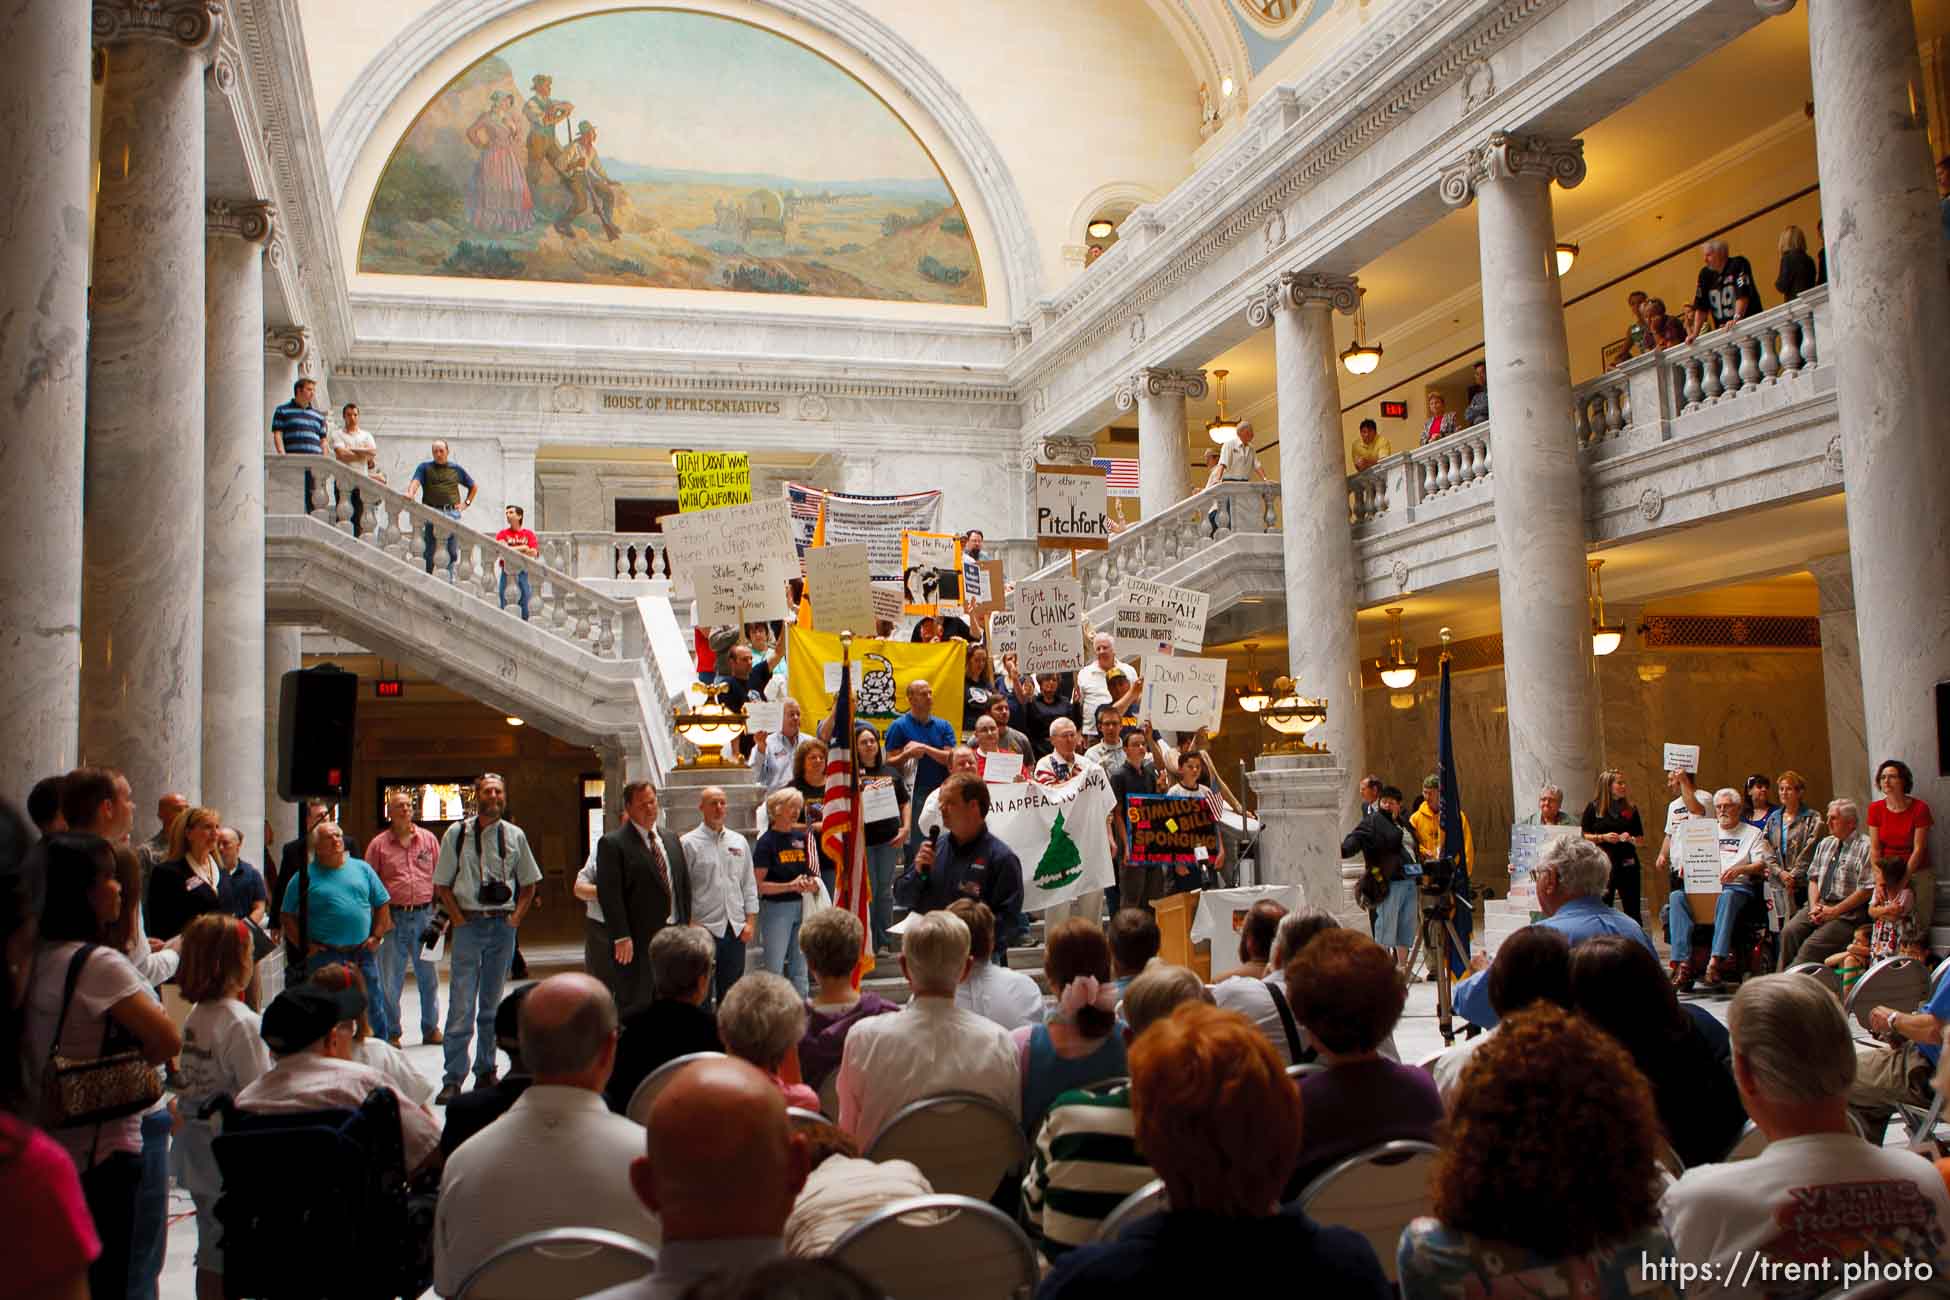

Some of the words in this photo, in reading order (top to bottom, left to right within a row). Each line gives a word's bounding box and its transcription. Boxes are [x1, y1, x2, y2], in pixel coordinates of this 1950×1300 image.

[603, 394, 643, 409] HOUSE
[646, 397, 661, 409] OF
[665, 397, 780, 414] REPRESENTATIVES
[676, 454, 699, 472] UTAH
[728, 454, 749, 469] WANT
[678, 473, 687, 490] TO
[1040, 475, 1052, 489] My
[1058, 476, 1076, 486] other
[680, 492, 699, 508] WITH
[702, 510, 721, 521] the
[721, 535, 750, 554] Utah
[1021, 587, 1045, 606] Fight
[1052, 587, 1069, 602] The
[1030, 602, 1075, 626] CHAINS
[1129, 593, 1154, 607] FOR
[1161, 599, 1196, 619] UTAH
[1118, 610, 1140, 623] STATES
[1116, 626, 1148, 640] INDIVIDUAL
[1151, 629, 1172, 641] RIGHTS
[1028, 639, 1069, 657] Gigantic
[1026, 653, 1082, 673] Government
[1152, 664, 1184, 683] Down
[1188, 664, 1216, 683] Size
[988, 800, 1003, 813] AN
[1180, 812, 1210, 831] BILL
[1135, 831, 1216, 849] SPONGING
